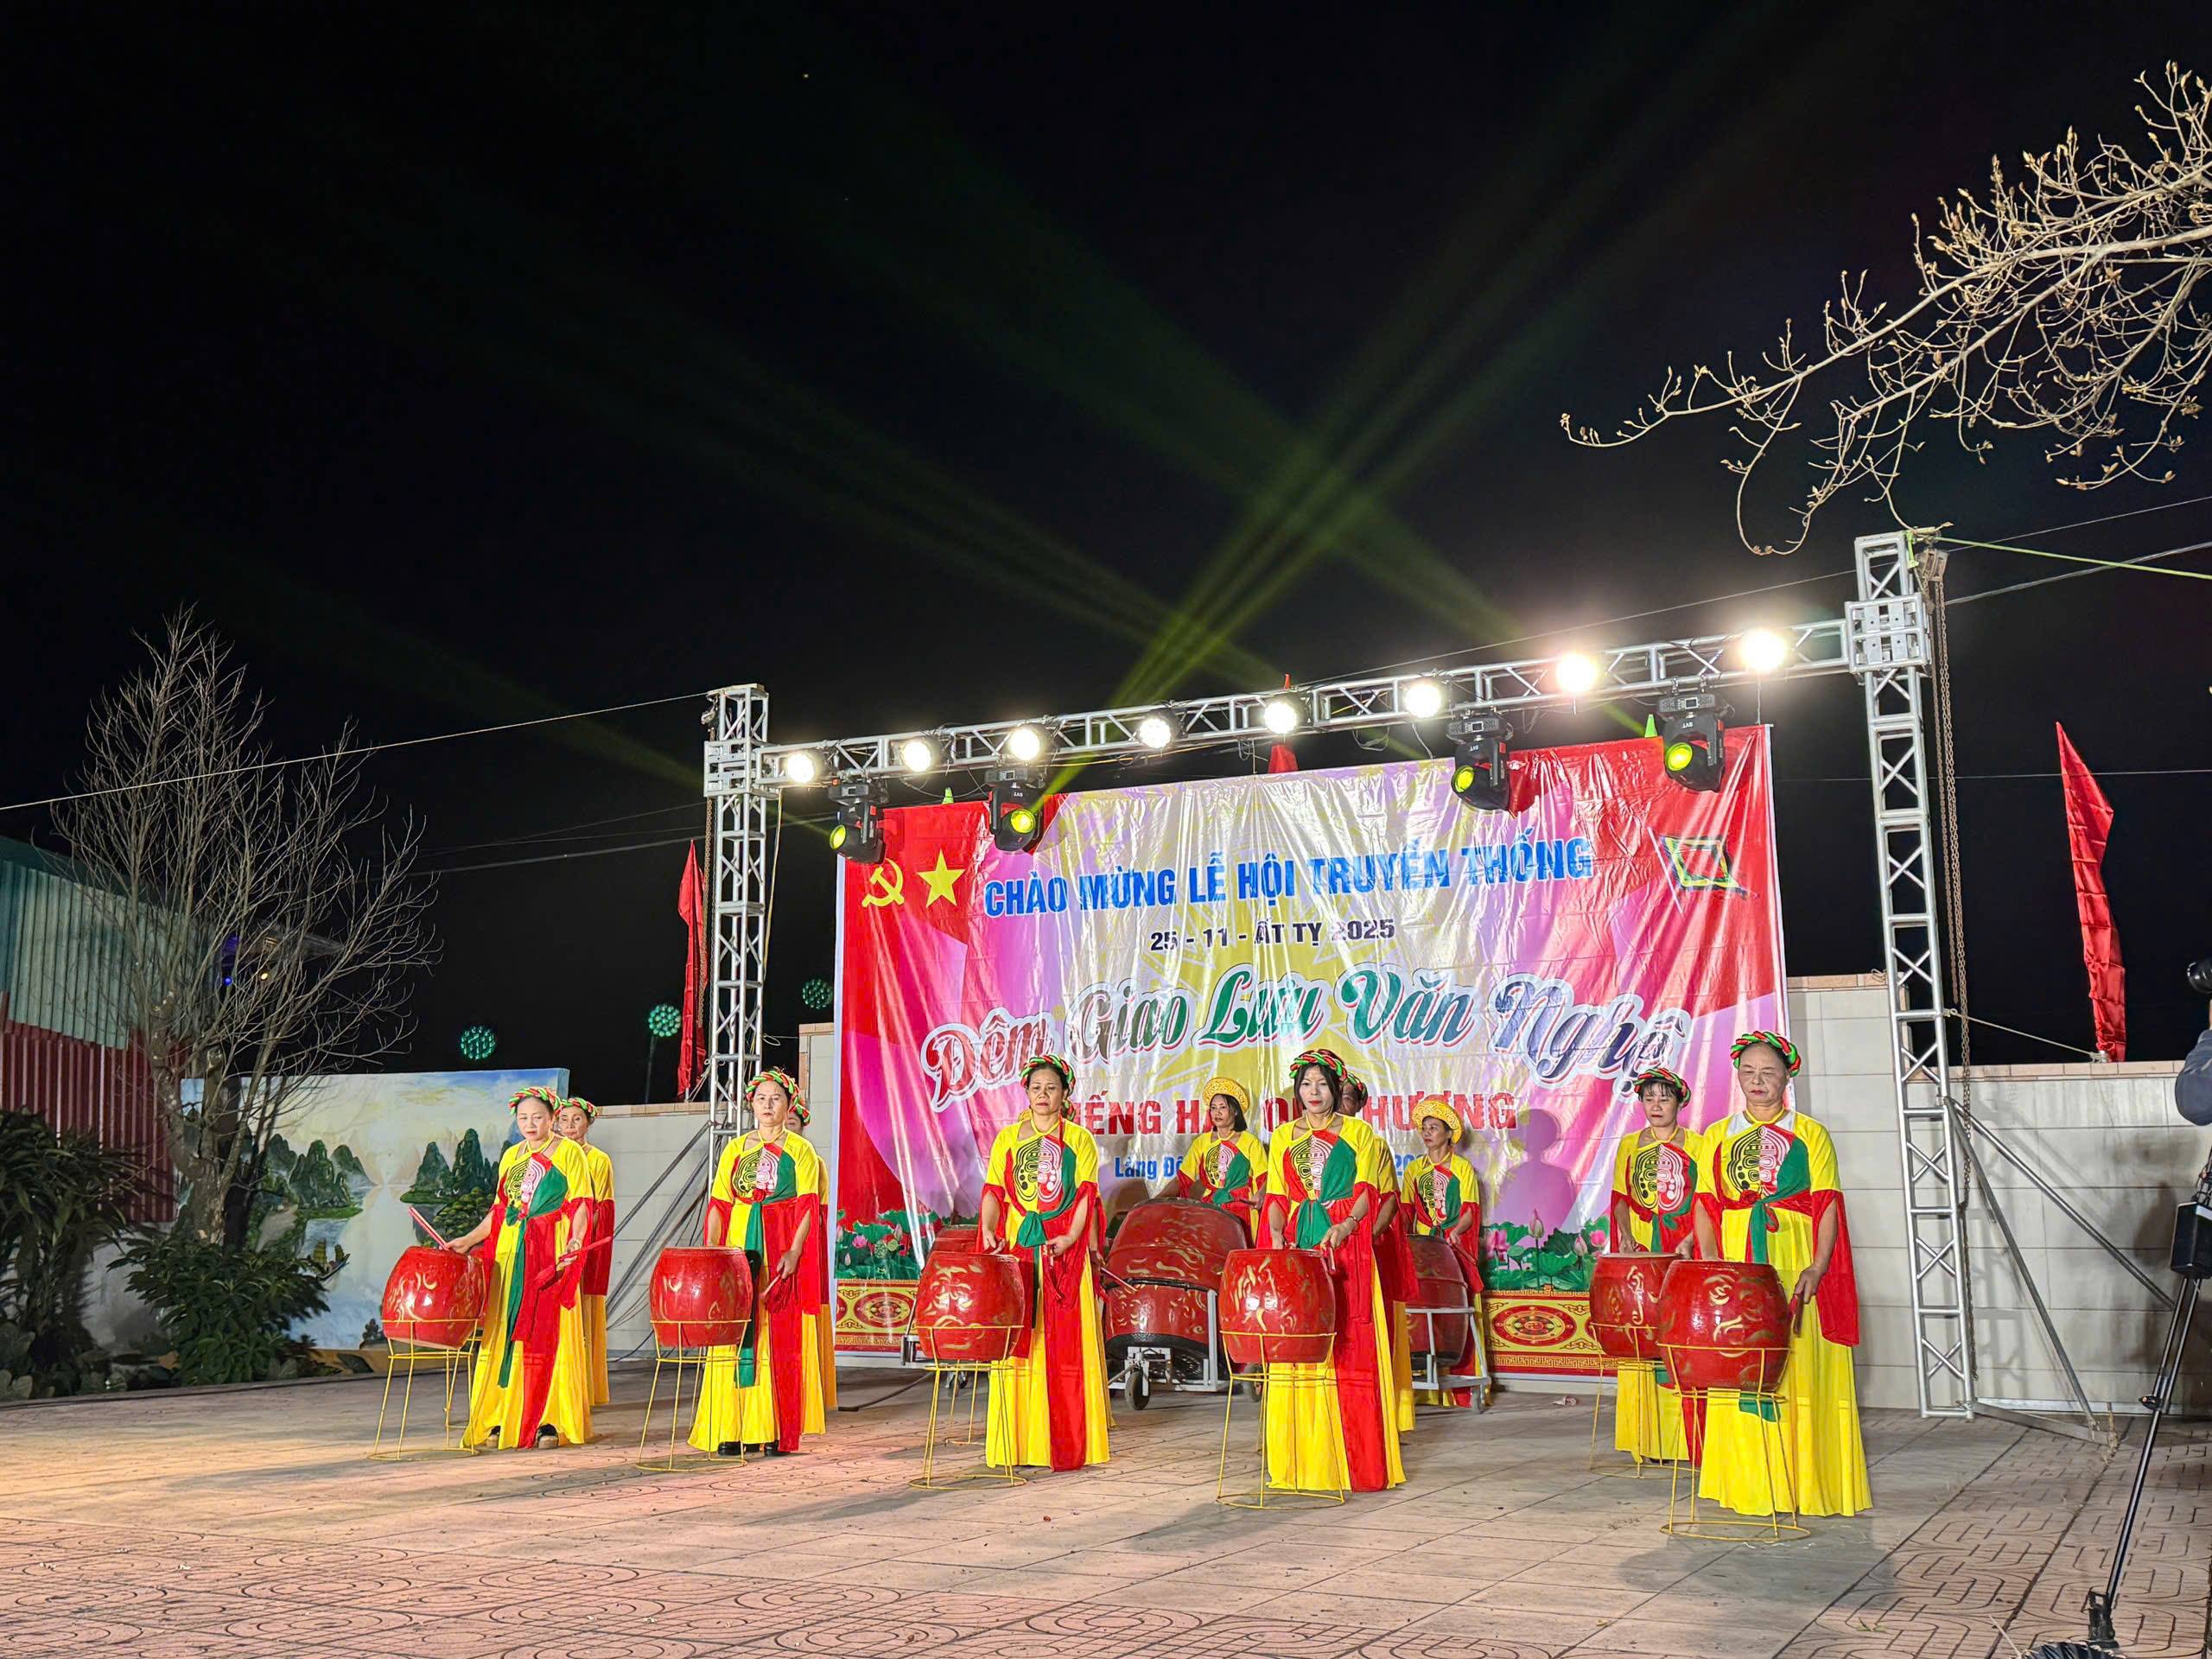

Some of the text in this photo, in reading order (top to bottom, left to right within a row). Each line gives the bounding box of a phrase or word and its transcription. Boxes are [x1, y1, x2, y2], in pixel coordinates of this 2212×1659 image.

[985, 870, 1068, 917] CHÀO
[1078, 864, 1176, 911] MỪNG
[1189, 851, 1226, 904] LỄ
[1237, 852, 1295, 906] HỘI
[1460, 827, 1593, 886] THỐNG
[1150, 931, 1179, 951] 25
[1203, 928, 1229, 948] 11
[925, 969, 1686, 1110] Đêm Giao Lưu Văn Nghệ
[1073, 1090, 1162, 1135] IẾNG
[1363, 1090, 1517, 1131] HƯNG
